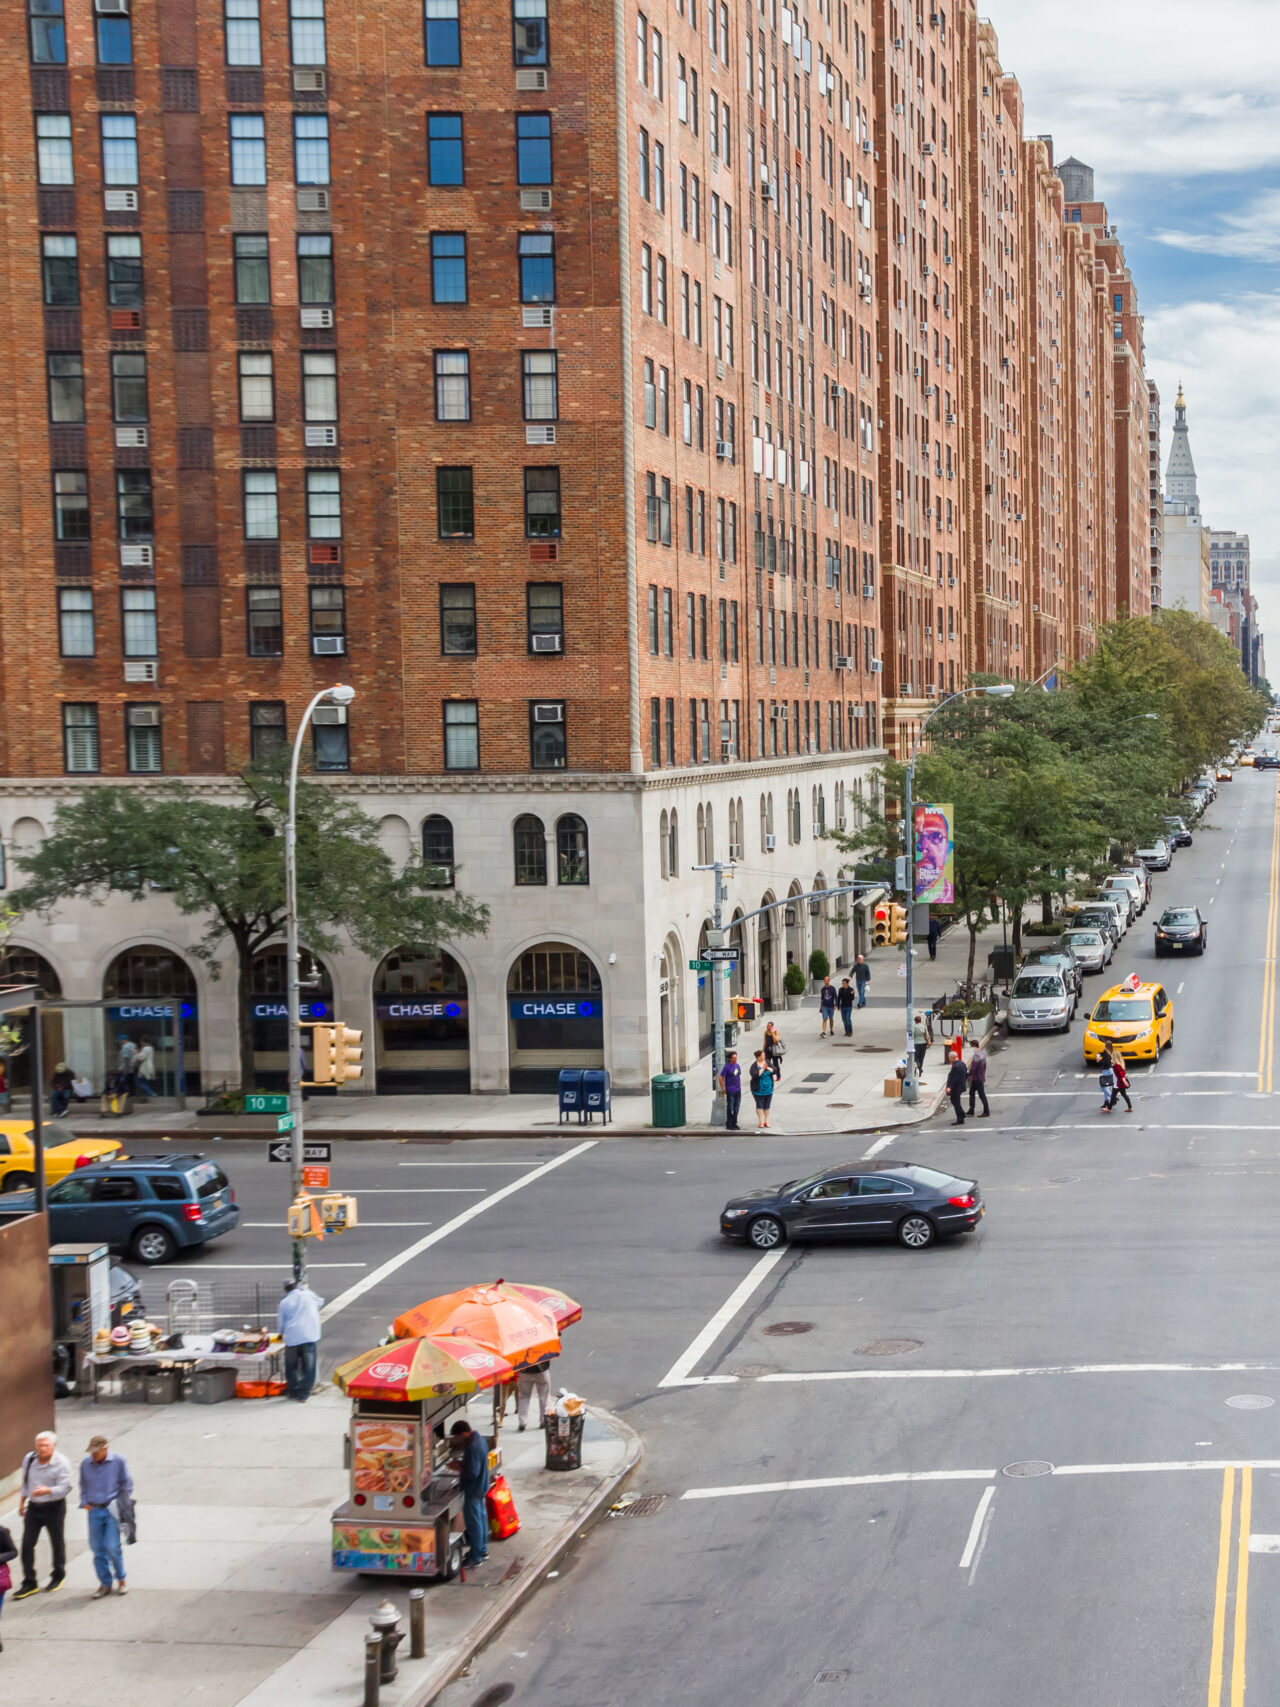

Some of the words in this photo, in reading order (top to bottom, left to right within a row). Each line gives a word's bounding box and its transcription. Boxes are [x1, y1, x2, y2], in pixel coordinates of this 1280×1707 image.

[692, 961, 700, 969] 10
[119, 1005, 174, 1017] CHASE
[255, 1004, 309, 1016] CHAE
[389, 1004, 443, 1016] CHASE
[523, 1003, 576, 1015] CHASE
[251, 1097, 265, 1110] 10
